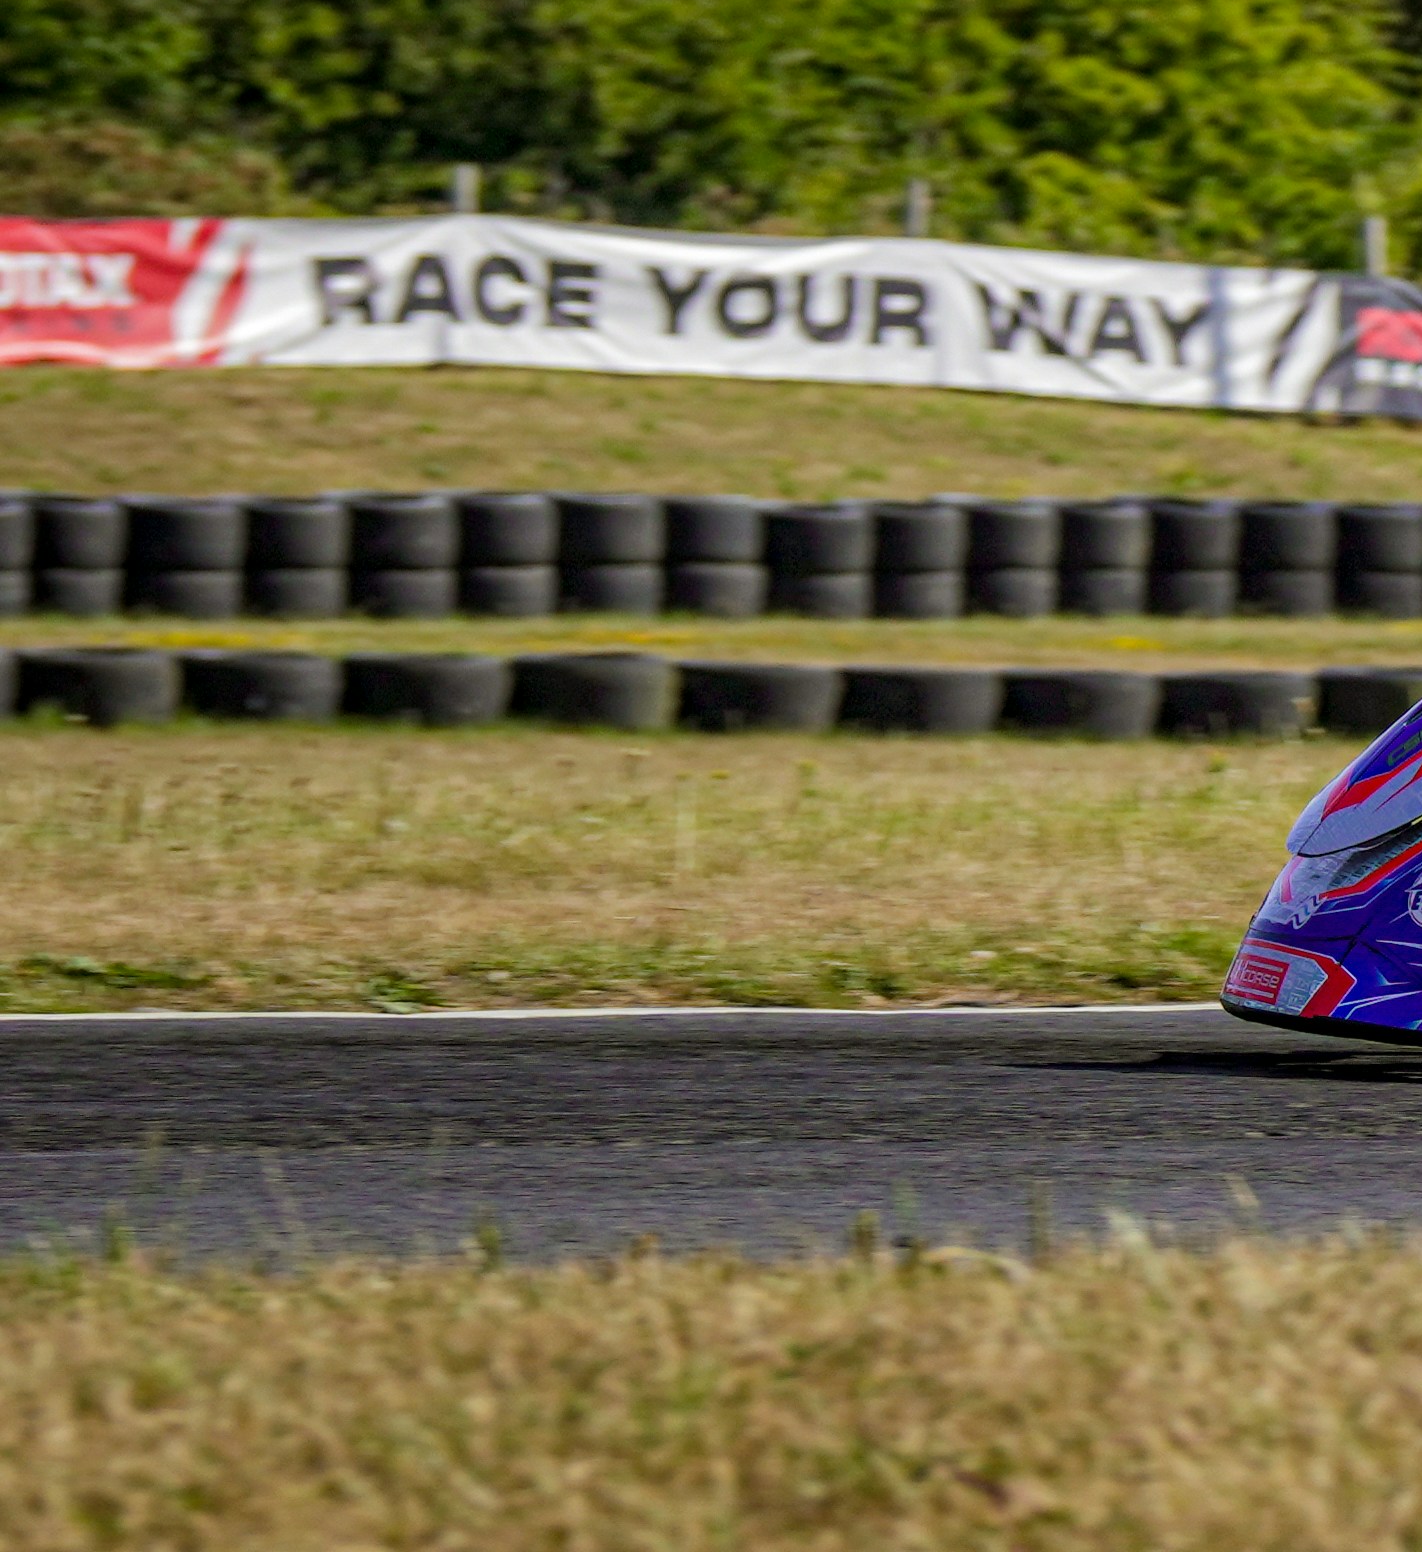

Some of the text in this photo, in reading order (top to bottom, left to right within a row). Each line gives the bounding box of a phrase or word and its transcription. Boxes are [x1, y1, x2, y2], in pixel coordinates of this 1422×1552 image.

[313, 255, 1211, 365] RACE YOUR WAY
